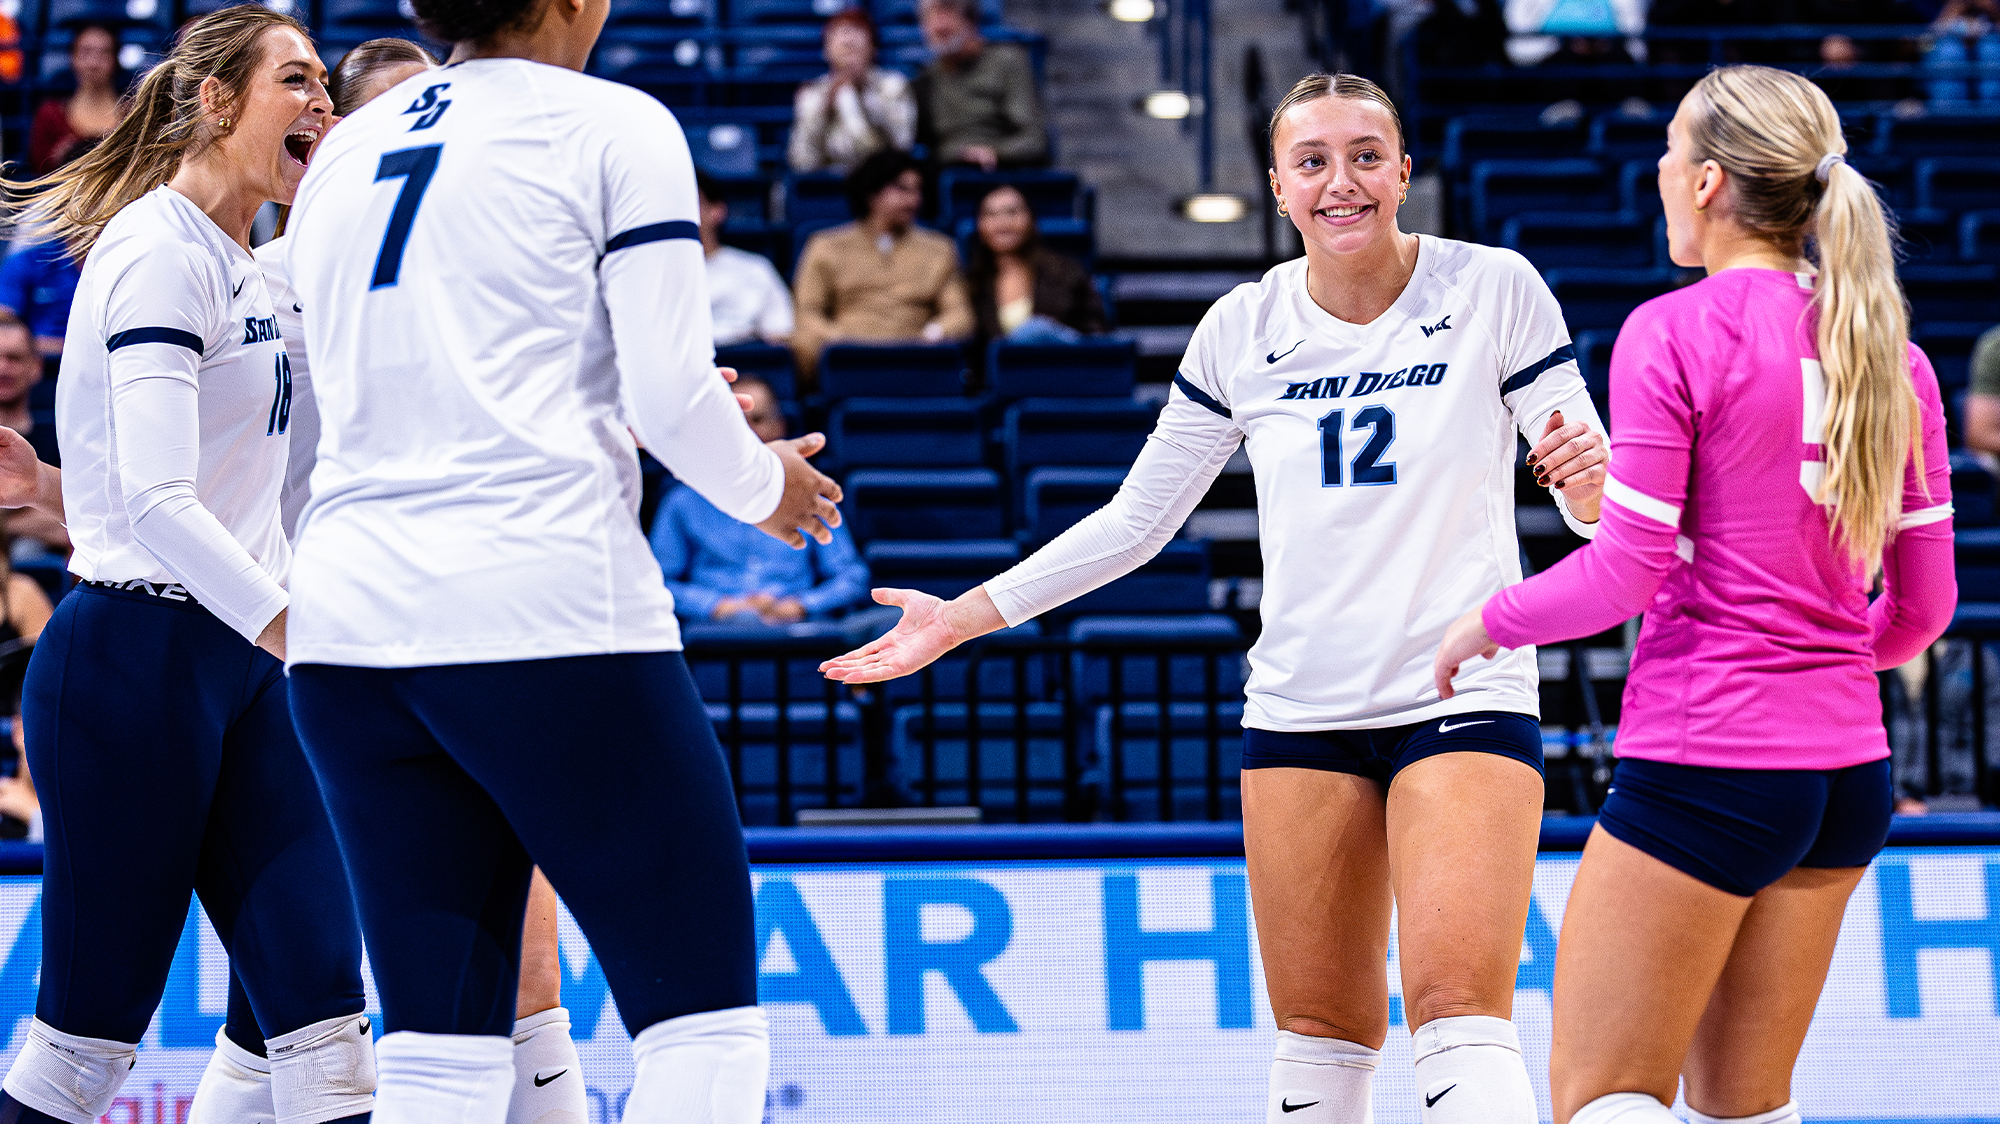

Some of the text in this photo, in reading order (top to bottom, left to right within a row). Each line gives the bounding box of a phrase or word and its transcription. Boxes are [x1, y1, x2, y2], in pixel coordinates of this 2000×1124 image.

[368, 142, 445, 292] 7
[267, 351, 292, 436] 18
[1274, 363, 1448, 401] SAN DIEGO
[1317, 403, 1397, 488] 12
